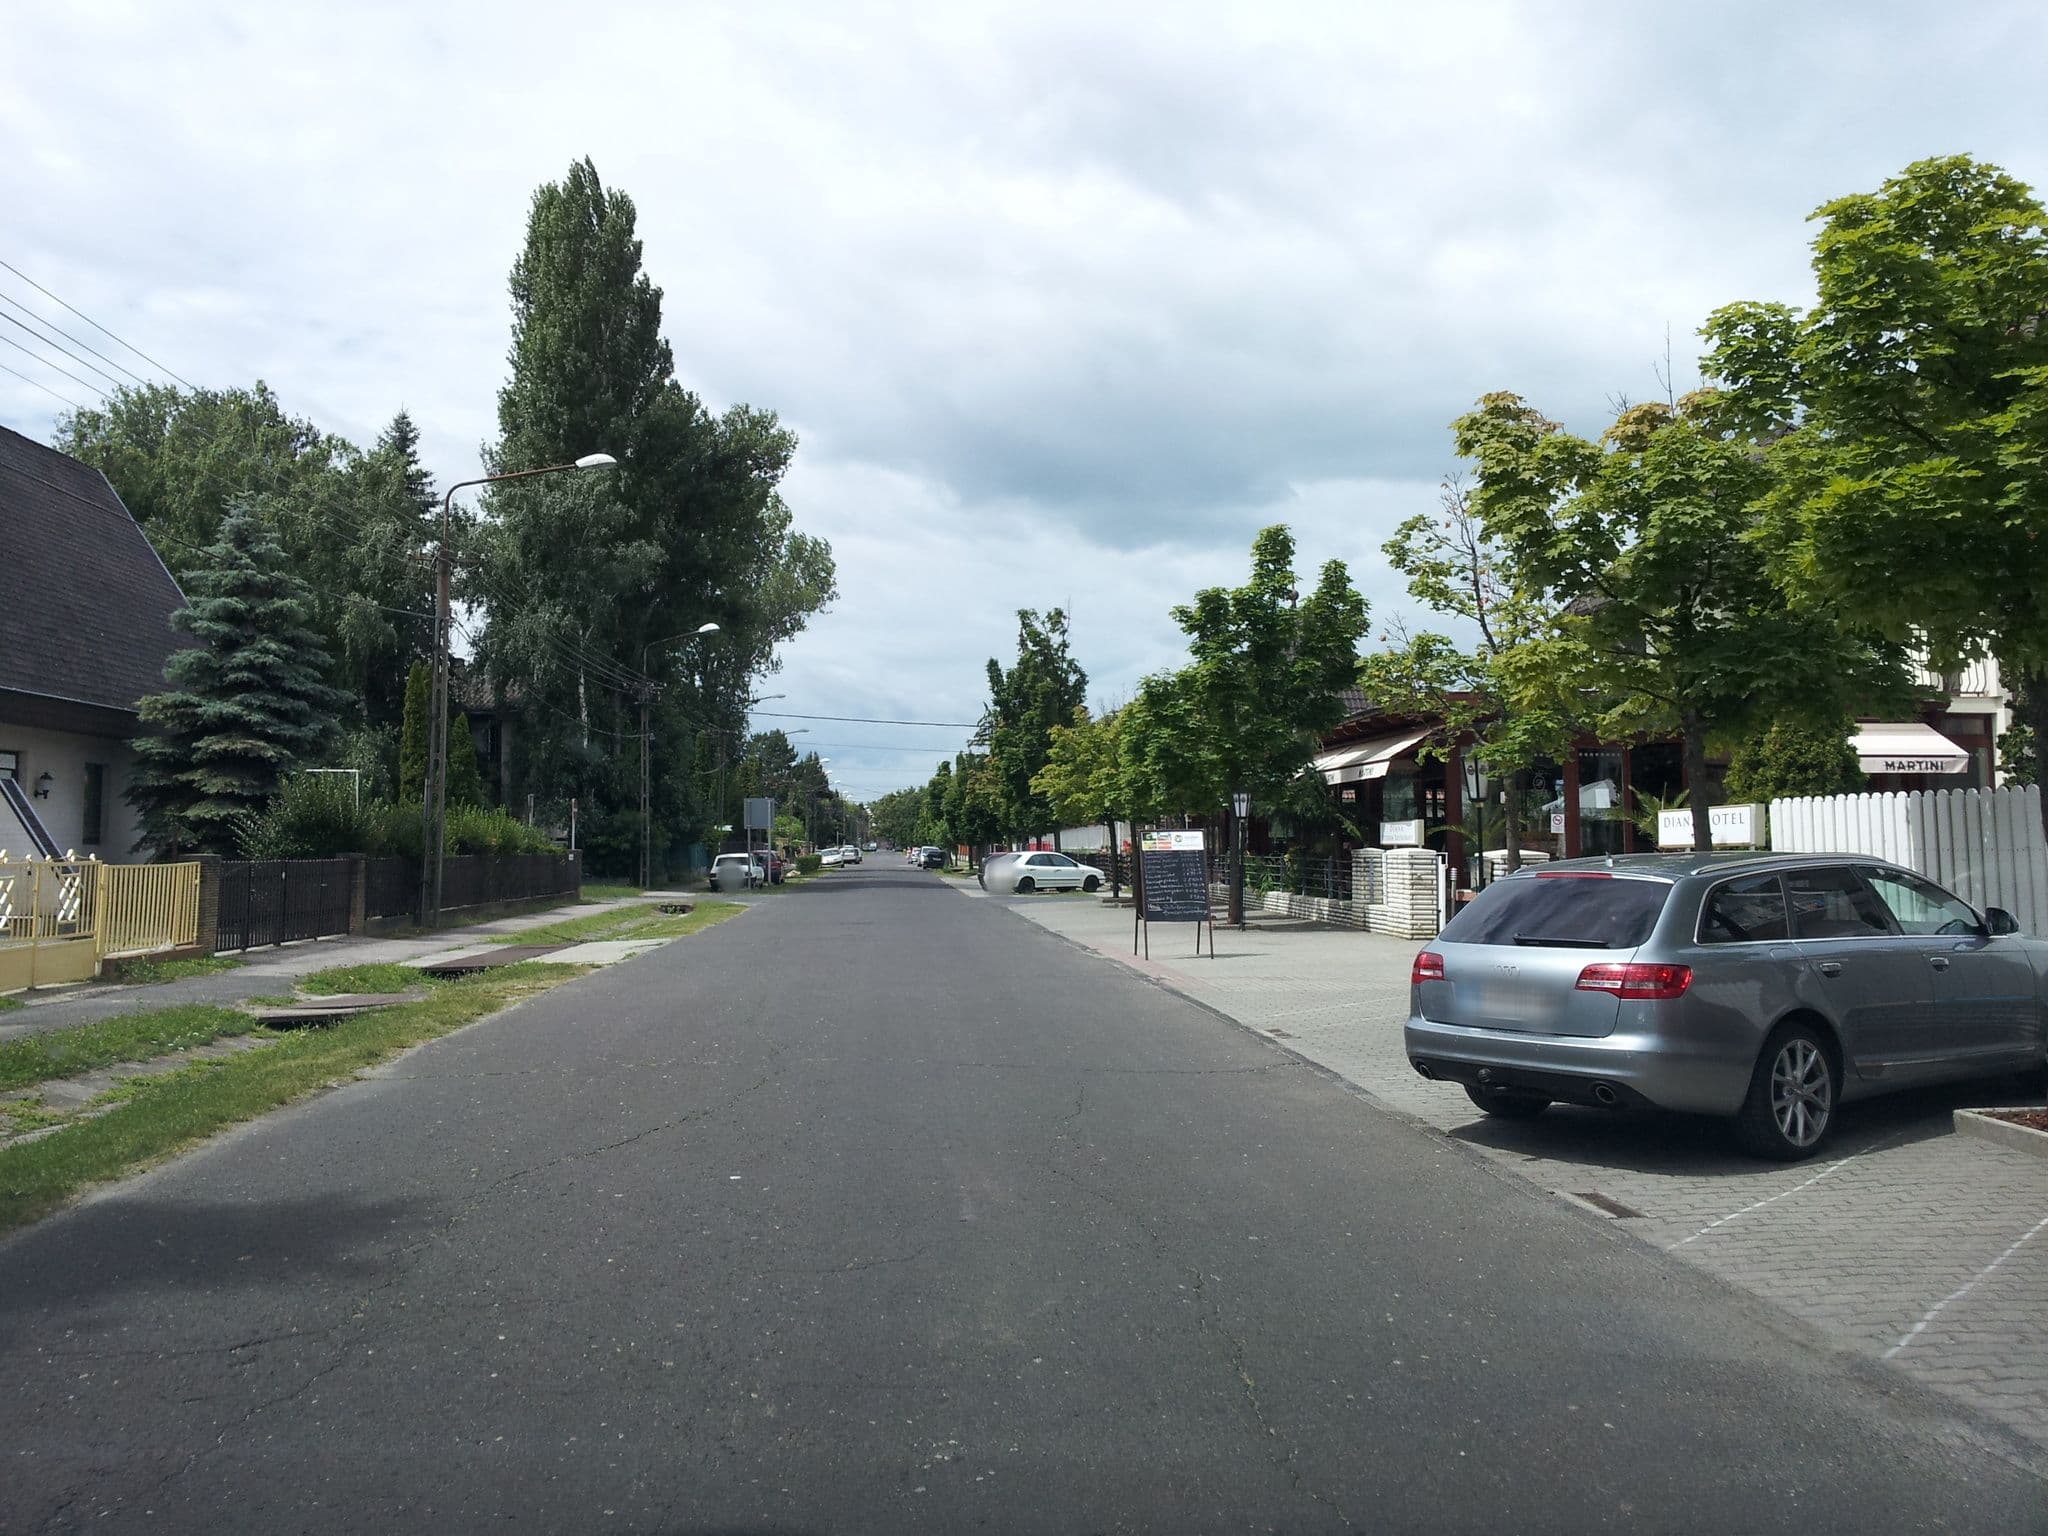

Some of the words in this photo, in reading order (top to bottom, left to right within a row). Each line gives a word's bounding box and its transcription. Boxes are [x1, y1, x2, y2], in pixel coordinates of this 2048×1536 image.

[1884, 760, 1944, 771] MARTINI
[1663, 815, 1691, 828] DIAN
[1711, 812, 1745, 826] OTEL
